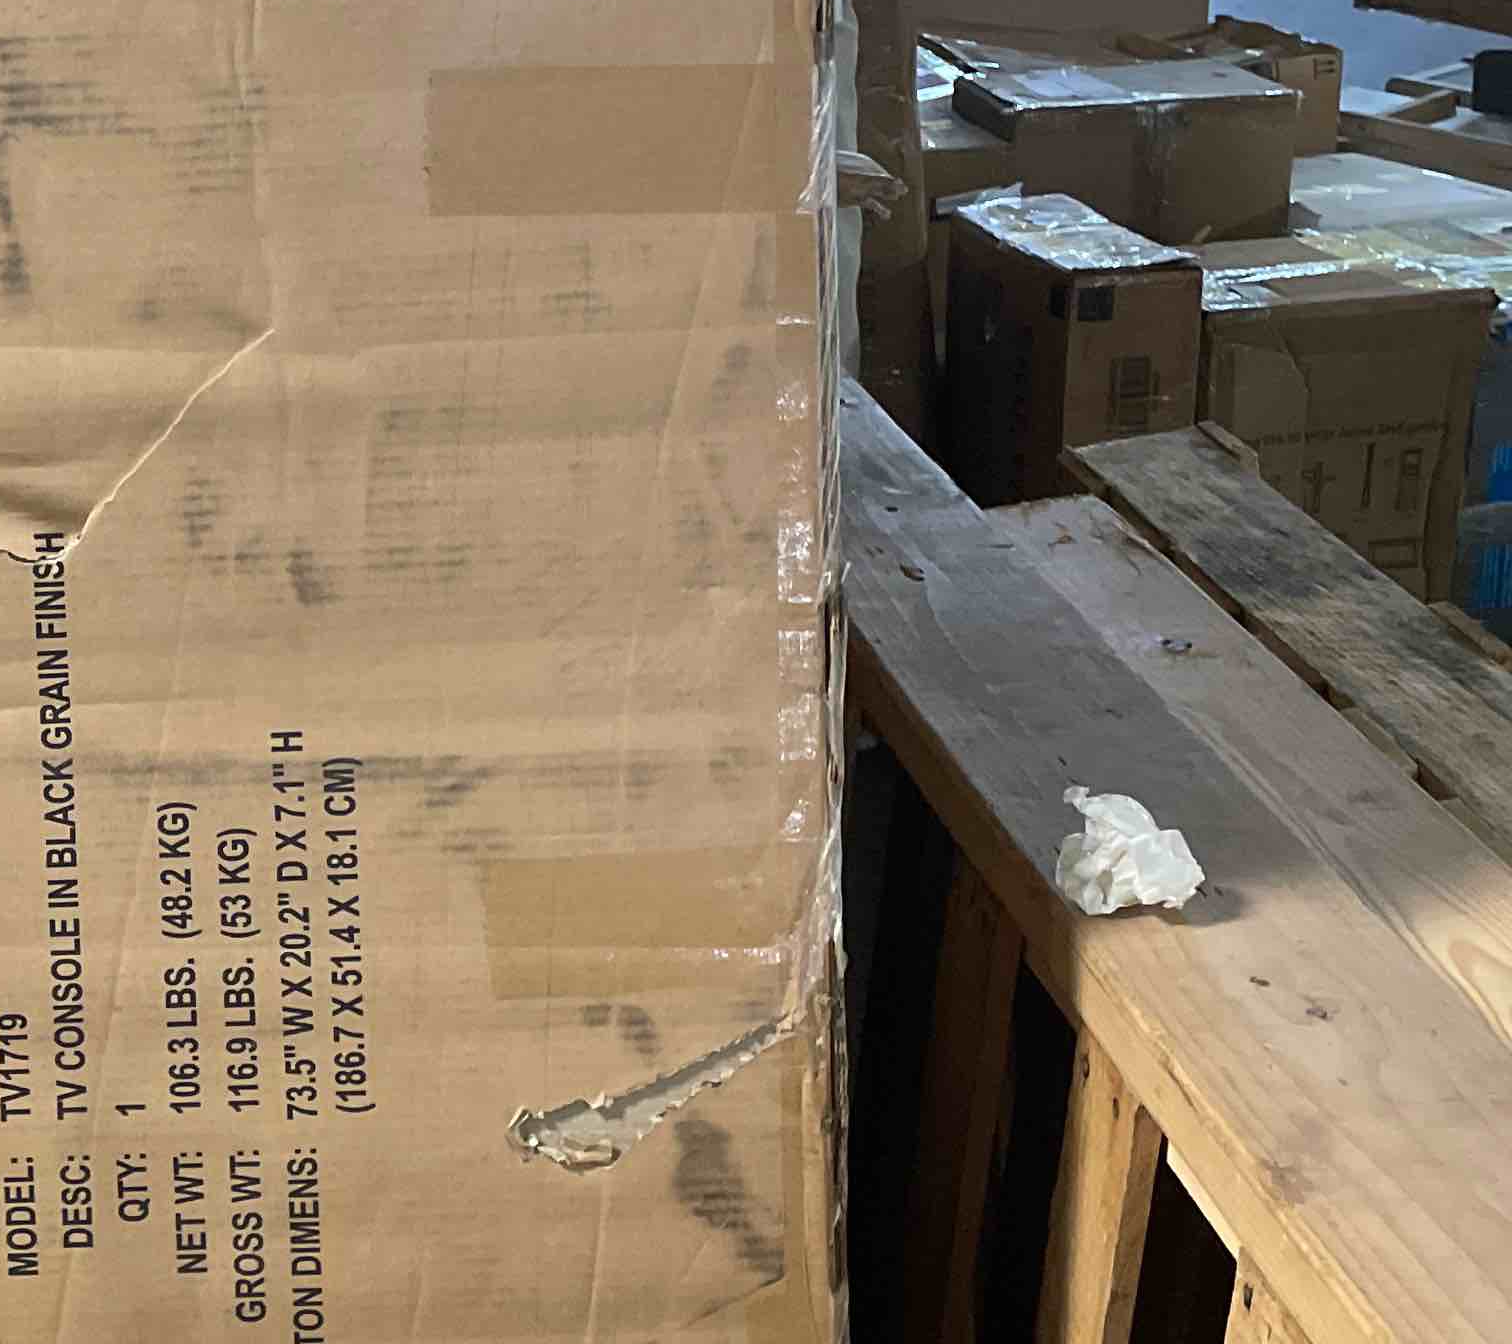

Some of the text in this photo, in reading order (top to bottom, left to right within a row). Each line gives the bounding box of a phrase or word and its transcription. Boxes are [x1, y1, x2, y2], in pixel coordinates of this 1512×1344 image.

[270, 731, 303, 753] H
[271, 763, 306, 822] 7.1"
[274, 829, 307, 851] X
[276, 860, 308, 882] D
[33, 532, 94, 1249] DESC: TV CONSOLE IN BLACK GRAIN FINISH
[277, 892, 312, 968] 20.2"
[321, 757, 377, 1113] (186.7 X 51.4 X 18.1 CM)
[280, 975, 313, 998] X
[281, 1006, 315, 1037] W
[156, 802, 209, 1274] NET WT: 106.3 LBS. (48.2 KG)
[216, 828, 267, 1323] GROSS WT: 116.9 LBS. (53 KG)
[283, 1044, 318, 1121] 73.5"
[114, 1104, 151, 1222] QTY: 1
[3, 1156, 39, 1276] MODEL:
[286, 1148, 323, 1277] DIMENS:
